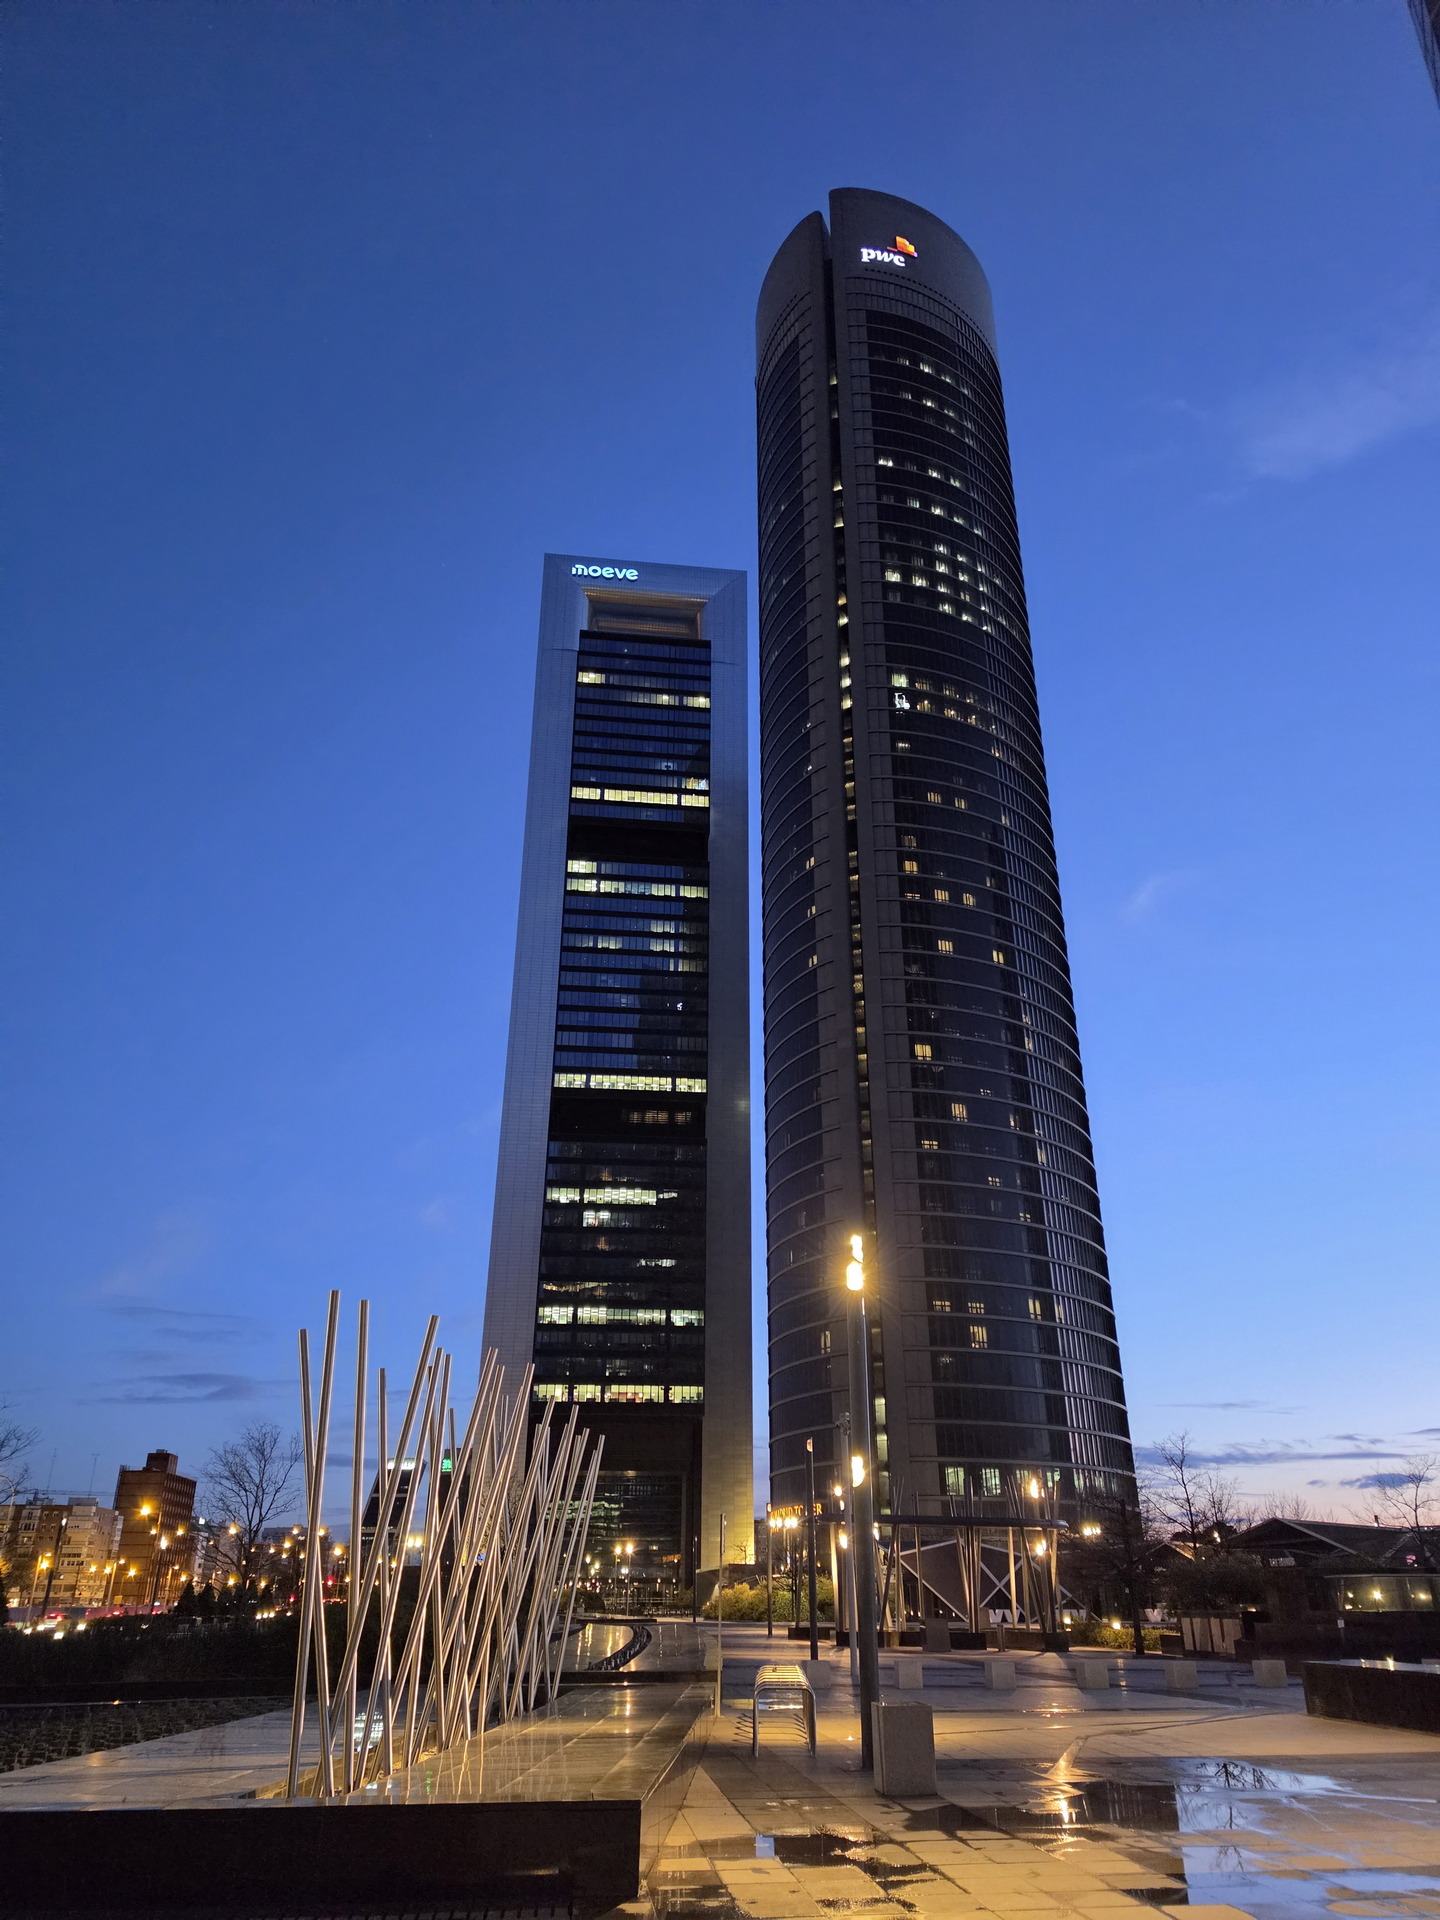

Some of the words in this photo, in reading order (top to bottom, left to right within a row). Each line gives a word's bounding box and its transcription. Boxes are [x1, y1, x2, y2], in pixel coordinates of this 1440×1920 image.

[860, 247, 905, 267] pwc
[571, 564, 639, 581] moeve
[793, 1503, 823, 1517] TOR
